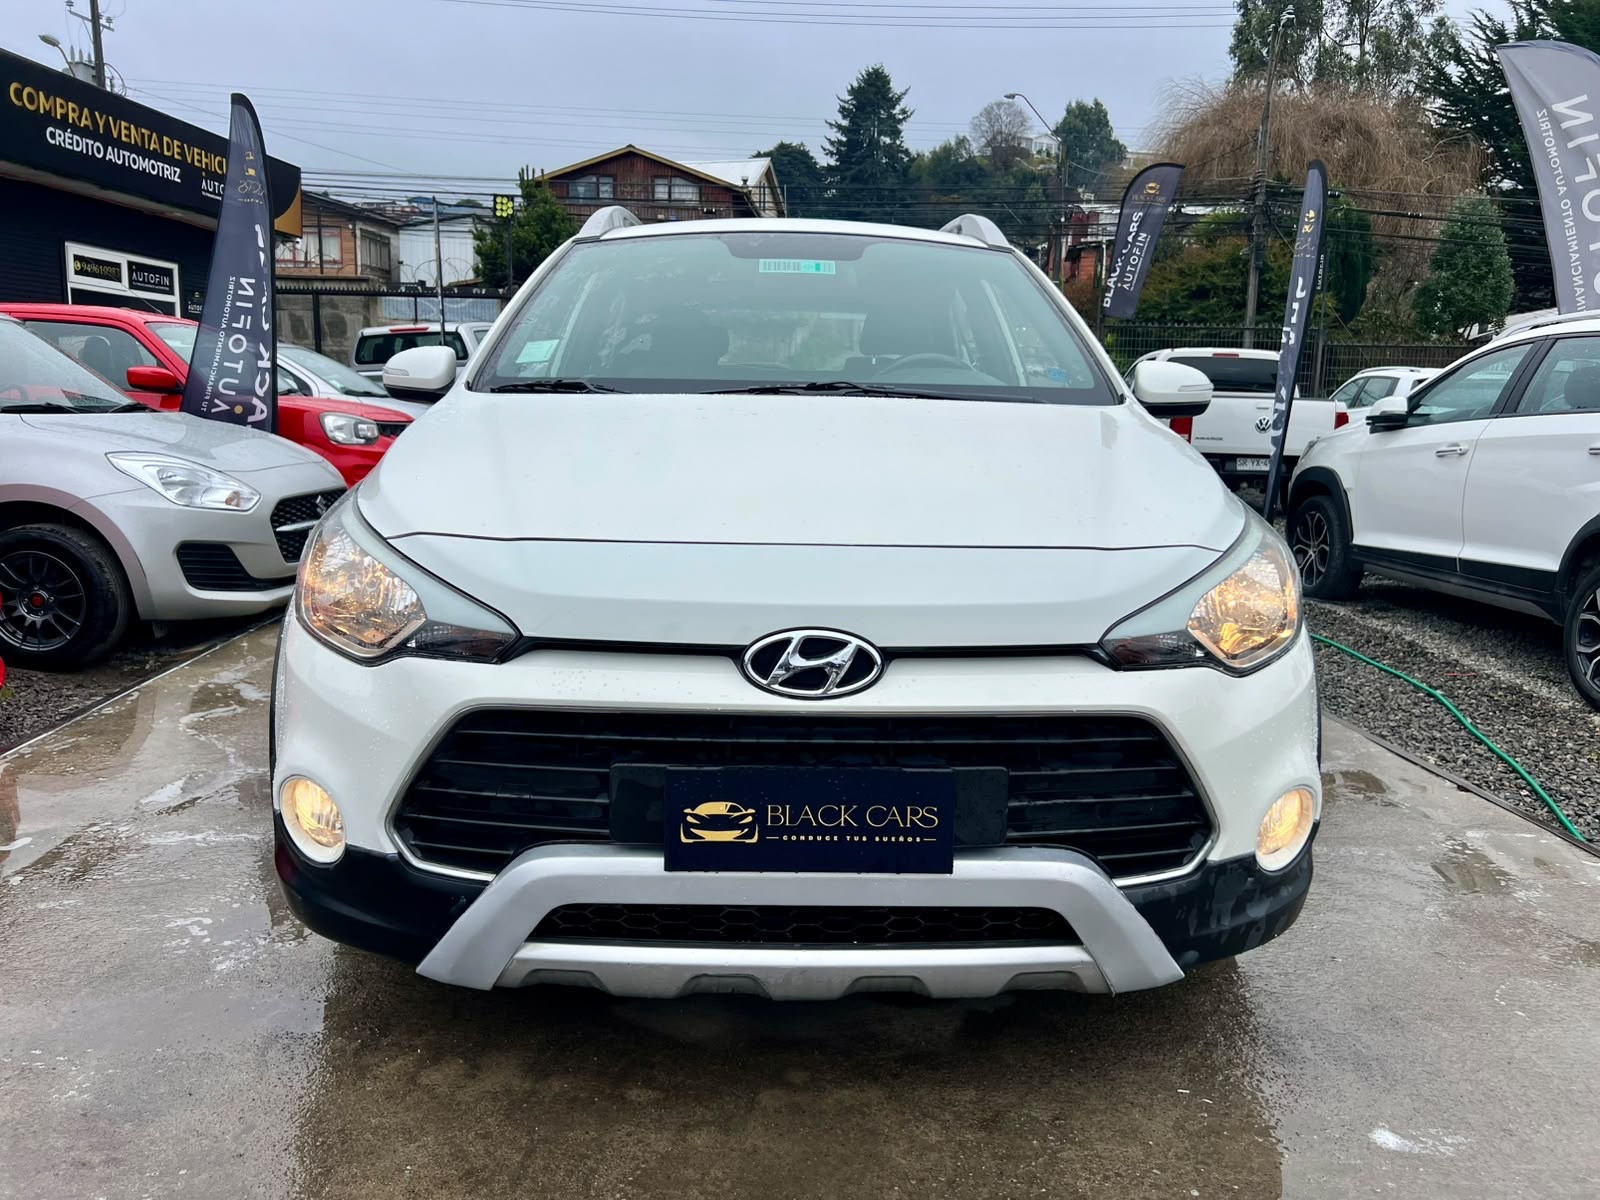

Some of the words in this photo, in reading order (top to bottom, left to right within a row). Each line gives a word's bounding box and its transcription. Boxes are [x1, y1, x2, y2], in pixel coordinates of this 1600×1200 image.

[9, 82, 93, 130] COMPRA
[95, 111, 107, 134] Y
[108, 116, 160, 153] VENTA
[163, 136, 182, 160] DE
[46, 128, 104, 159] CRÉDITO
[105, 146, 181, 183] AUTOMOTRIZ
[132, 271, 170, 286] AUTOFIN
[1122, 233, 1147, 290] AUTOFIN
[766, 804, 858, 827] BLACK
[866, 805, 939, 828] CARS
